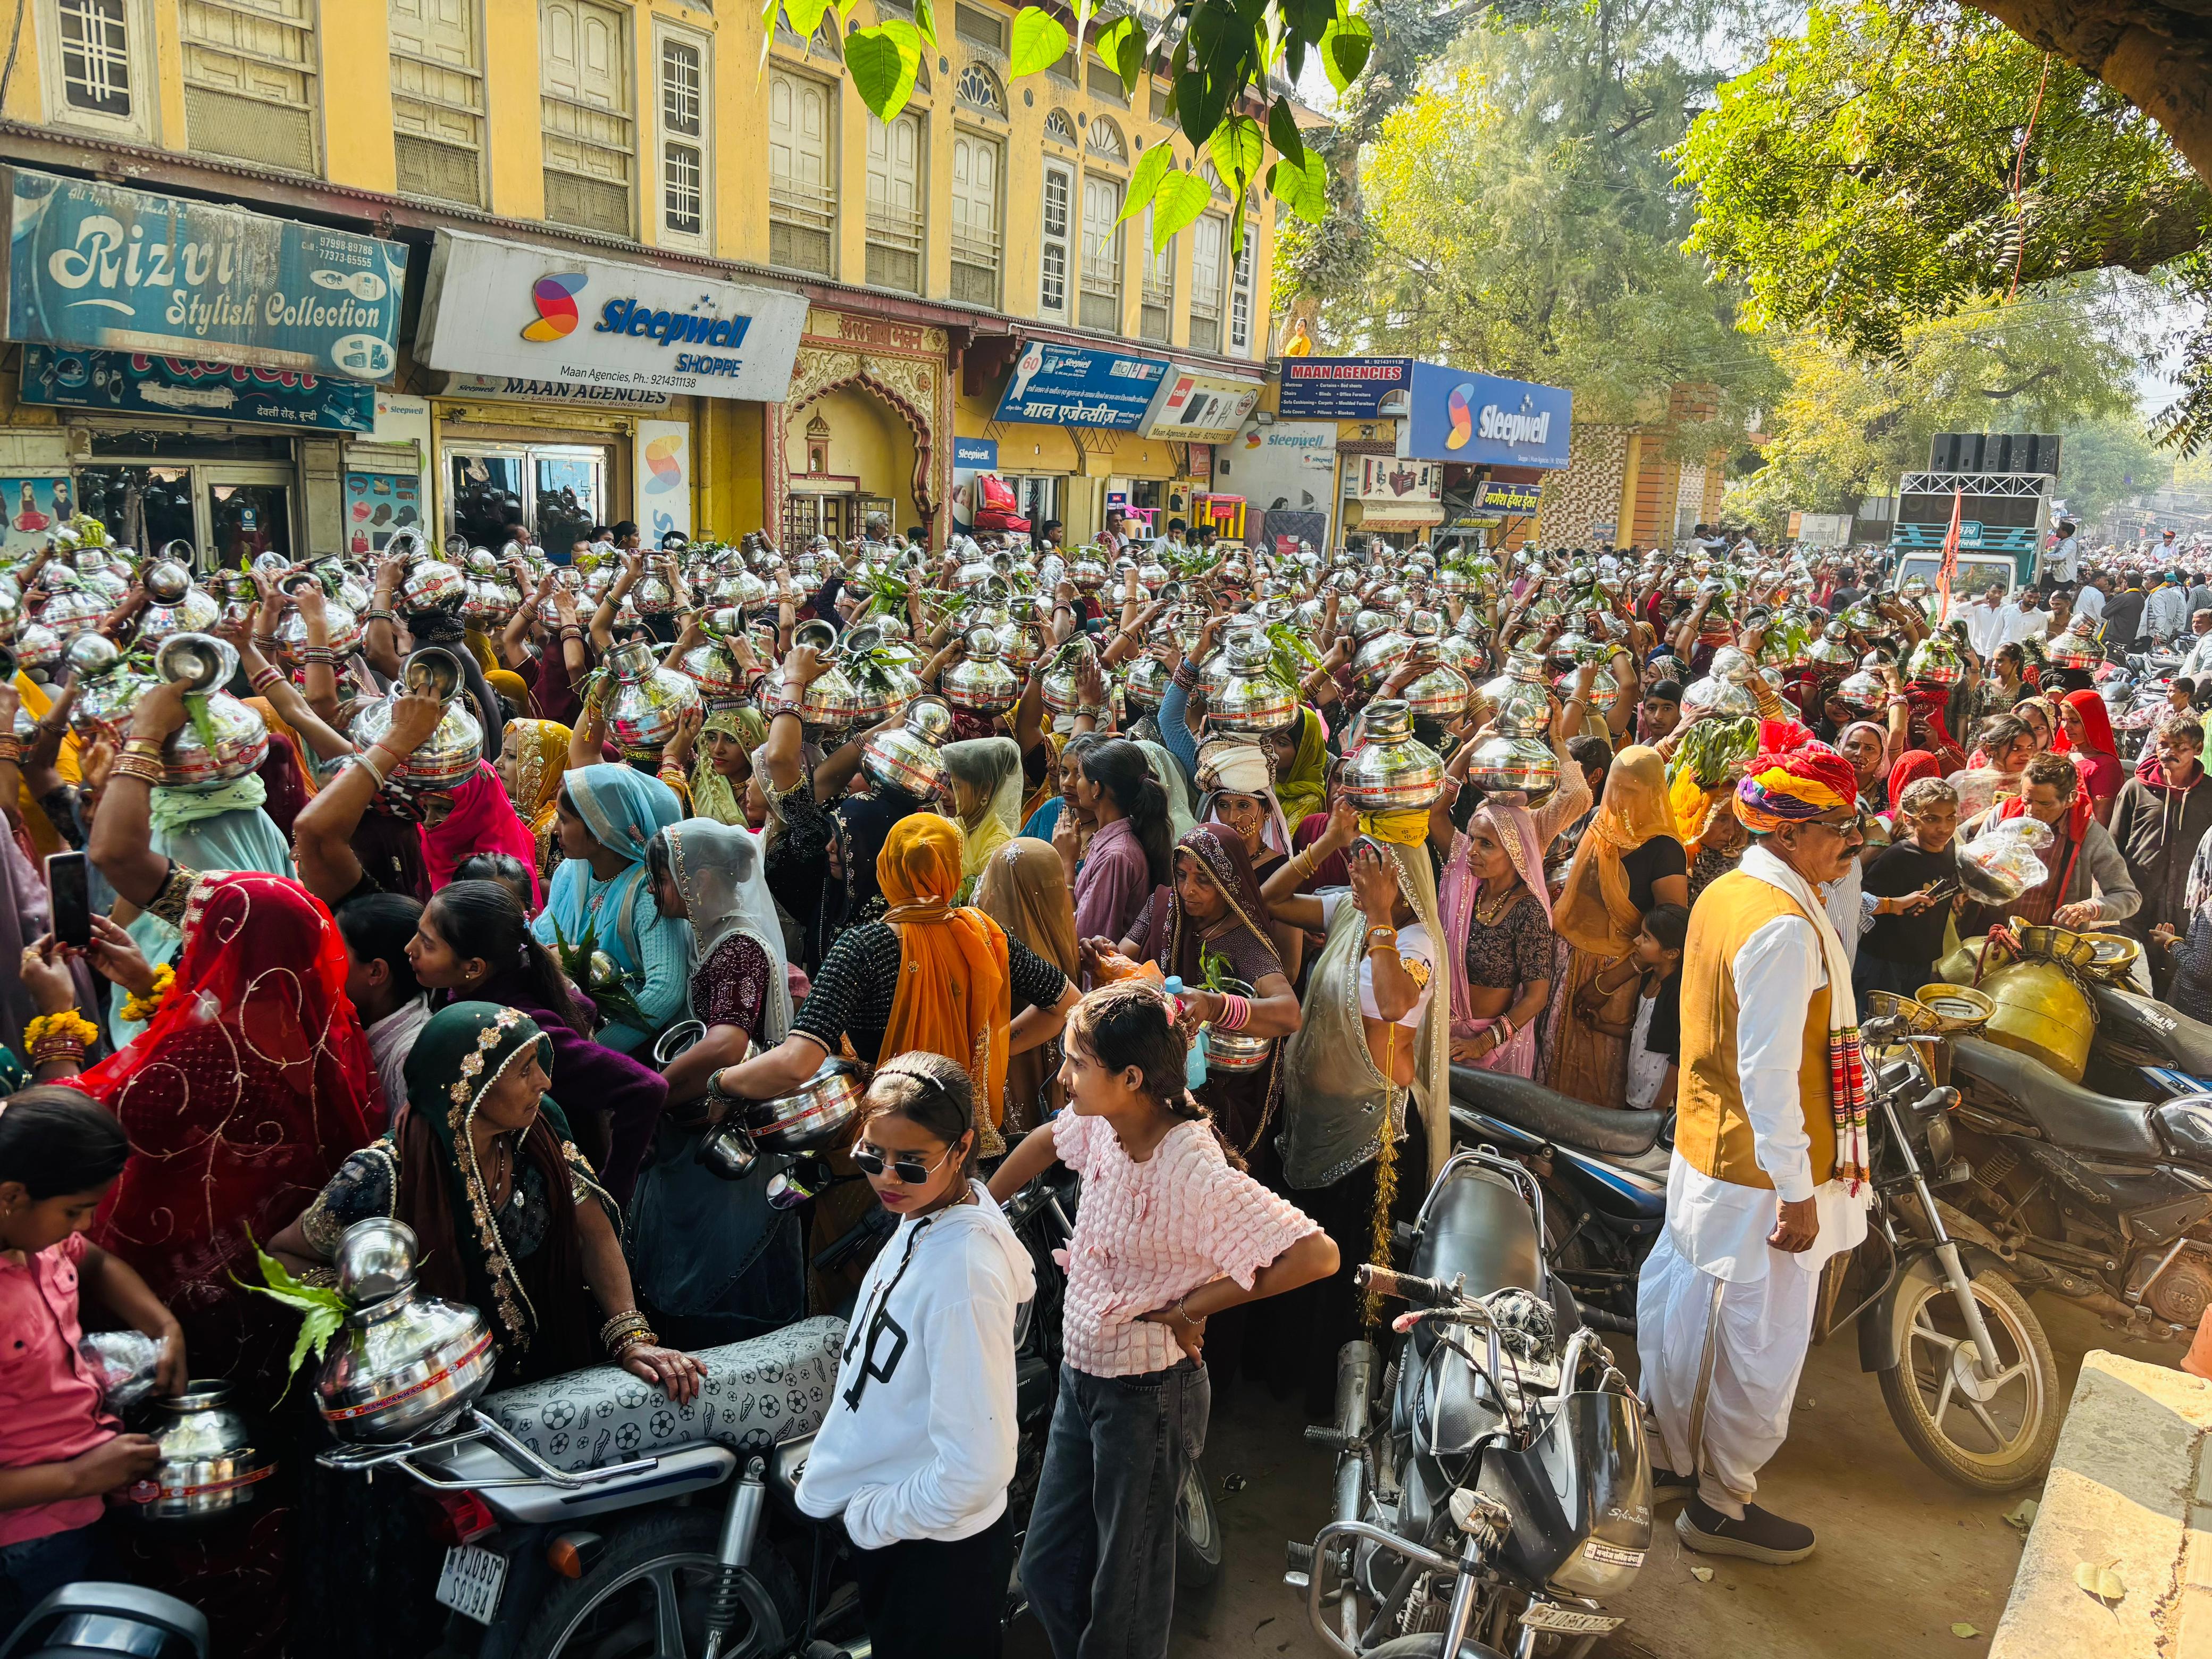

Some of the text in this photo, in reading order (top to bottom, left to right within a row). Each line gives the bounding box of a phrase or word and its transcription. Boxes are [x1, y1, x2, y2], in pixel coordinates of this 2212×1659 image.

[48, 215, 236, 290] Rizvi
[320, 237, 373, 256] 97998-89786
[320, 249, 372, 267] 77373-65555
[166, 289, 380, 336] Stylish Collection
[594, 298, 752, 348] Sleepwell
[197, 343, 220, 355] Girls
[260, 350, 279, 363] Kids
[282, 354, 306, 365] Wear
[1064, 357, 1092, 368] Sleepwell
[675, 353, 743, 378] SHOPPE
[1022, 357, 1040, 371] 60
[1291, 365, 1402, 381] MAAN AGENCIES
[560, 365, 587, 378] Maan
[590, 369, 631, 383] Agencies,
[651, 374, 697, 389] 9214311138
[458, 383, 495, 393] Sleepwell
[502, 377, 571, 397] MAAN
[257, 404, 279, 417] देवली
[299, 409, 317, 422] बून्दी
[390, 406, 424, 415] Sleepwell
[1023, 402, 1059, 419] मान
[1152, 428, 1166, 437] Maan
[1479, 404, 1551, 447] Sleepwell
[1267, 433, 1324, 448] Sleepwell
[958, 448, 989, 461] Sleepwell
[1484, 488, 1508, 506] गणेश
